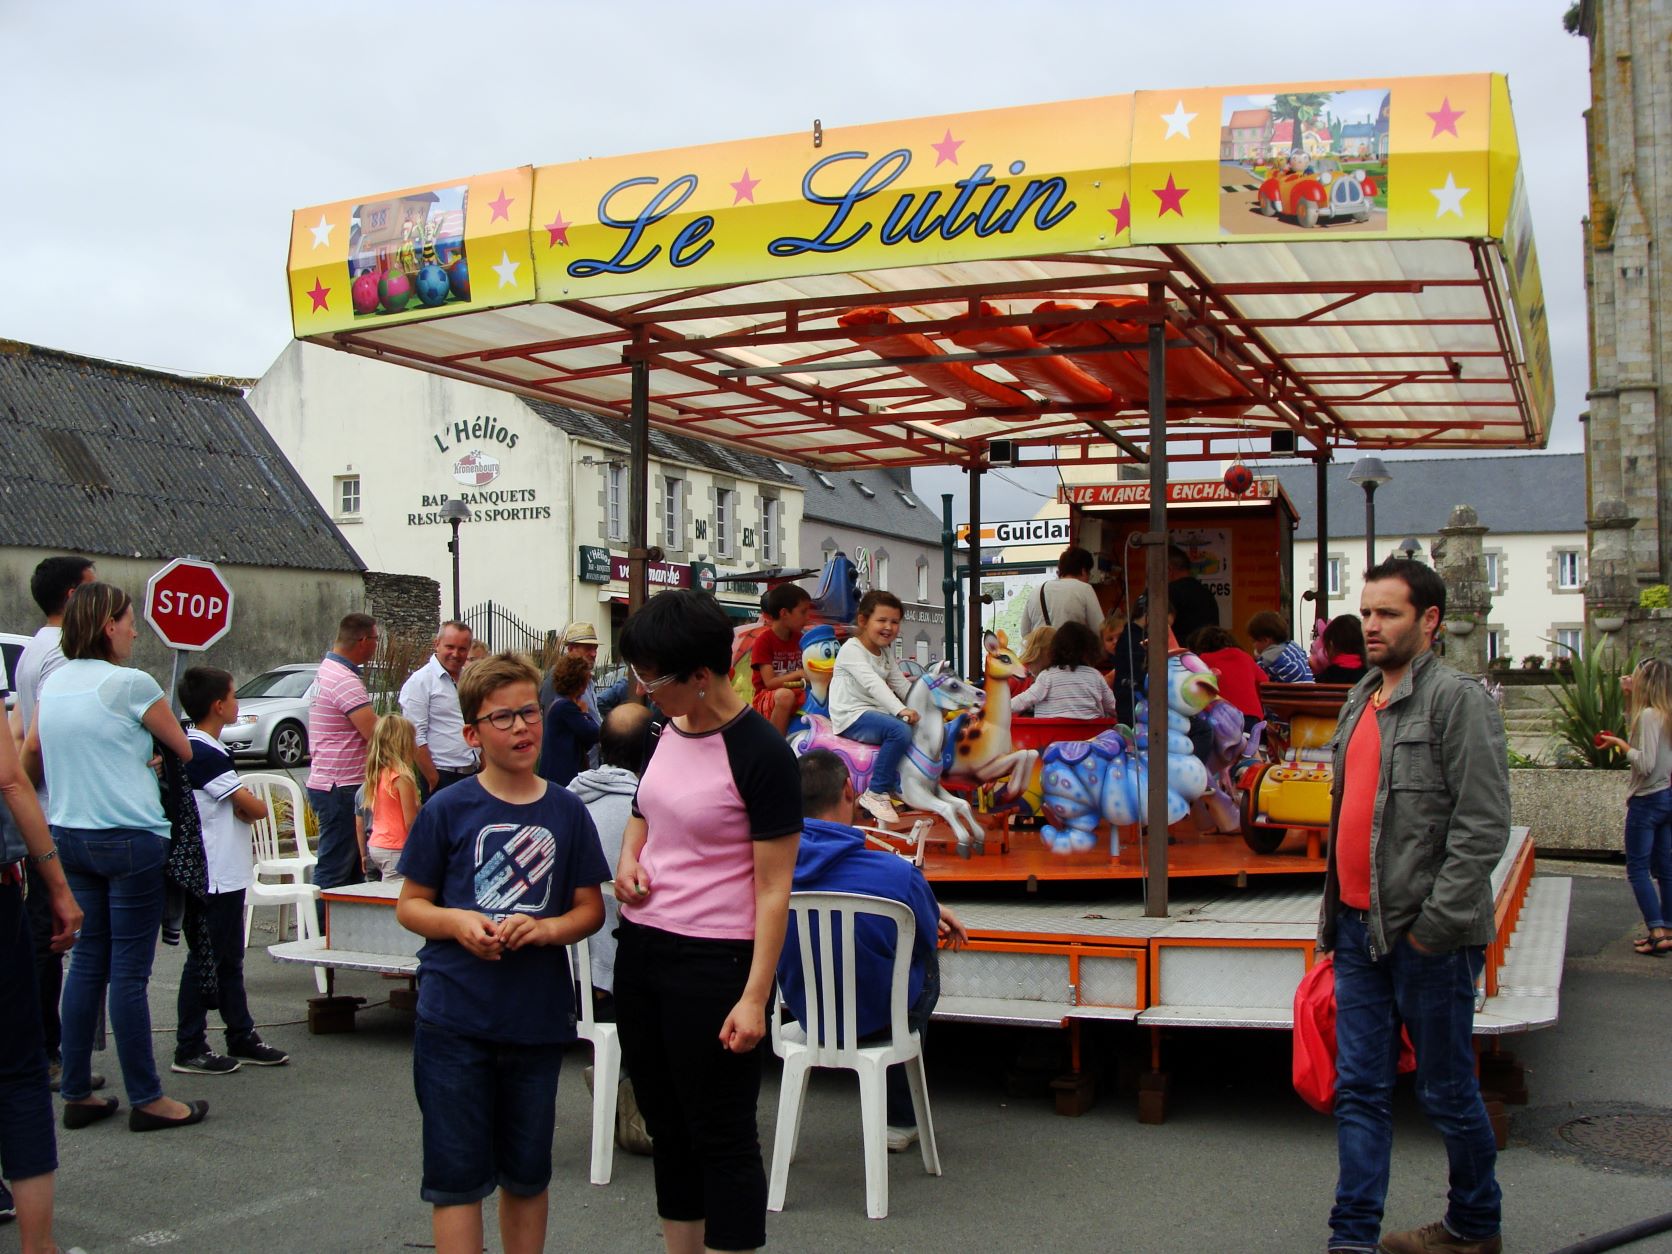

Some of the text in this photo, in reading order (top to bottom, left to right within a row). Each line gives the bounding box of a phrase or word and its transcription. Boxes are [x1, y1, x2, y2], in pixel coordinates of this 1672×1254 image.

[567, 149, 1077, 278] Le Lutin
[434, 416, 519, 454] L'Hélios
[454, 462, 500, 475] Kronenbourg
[461, 489, 536, 505] BANQUETS
[1077, 488, 1094, 504] LE
[408, 506, 551, 526] RESUS SPORTIFS
[695, 518, 707, 540] BAR
[157, 589, 223, 620] STOP
